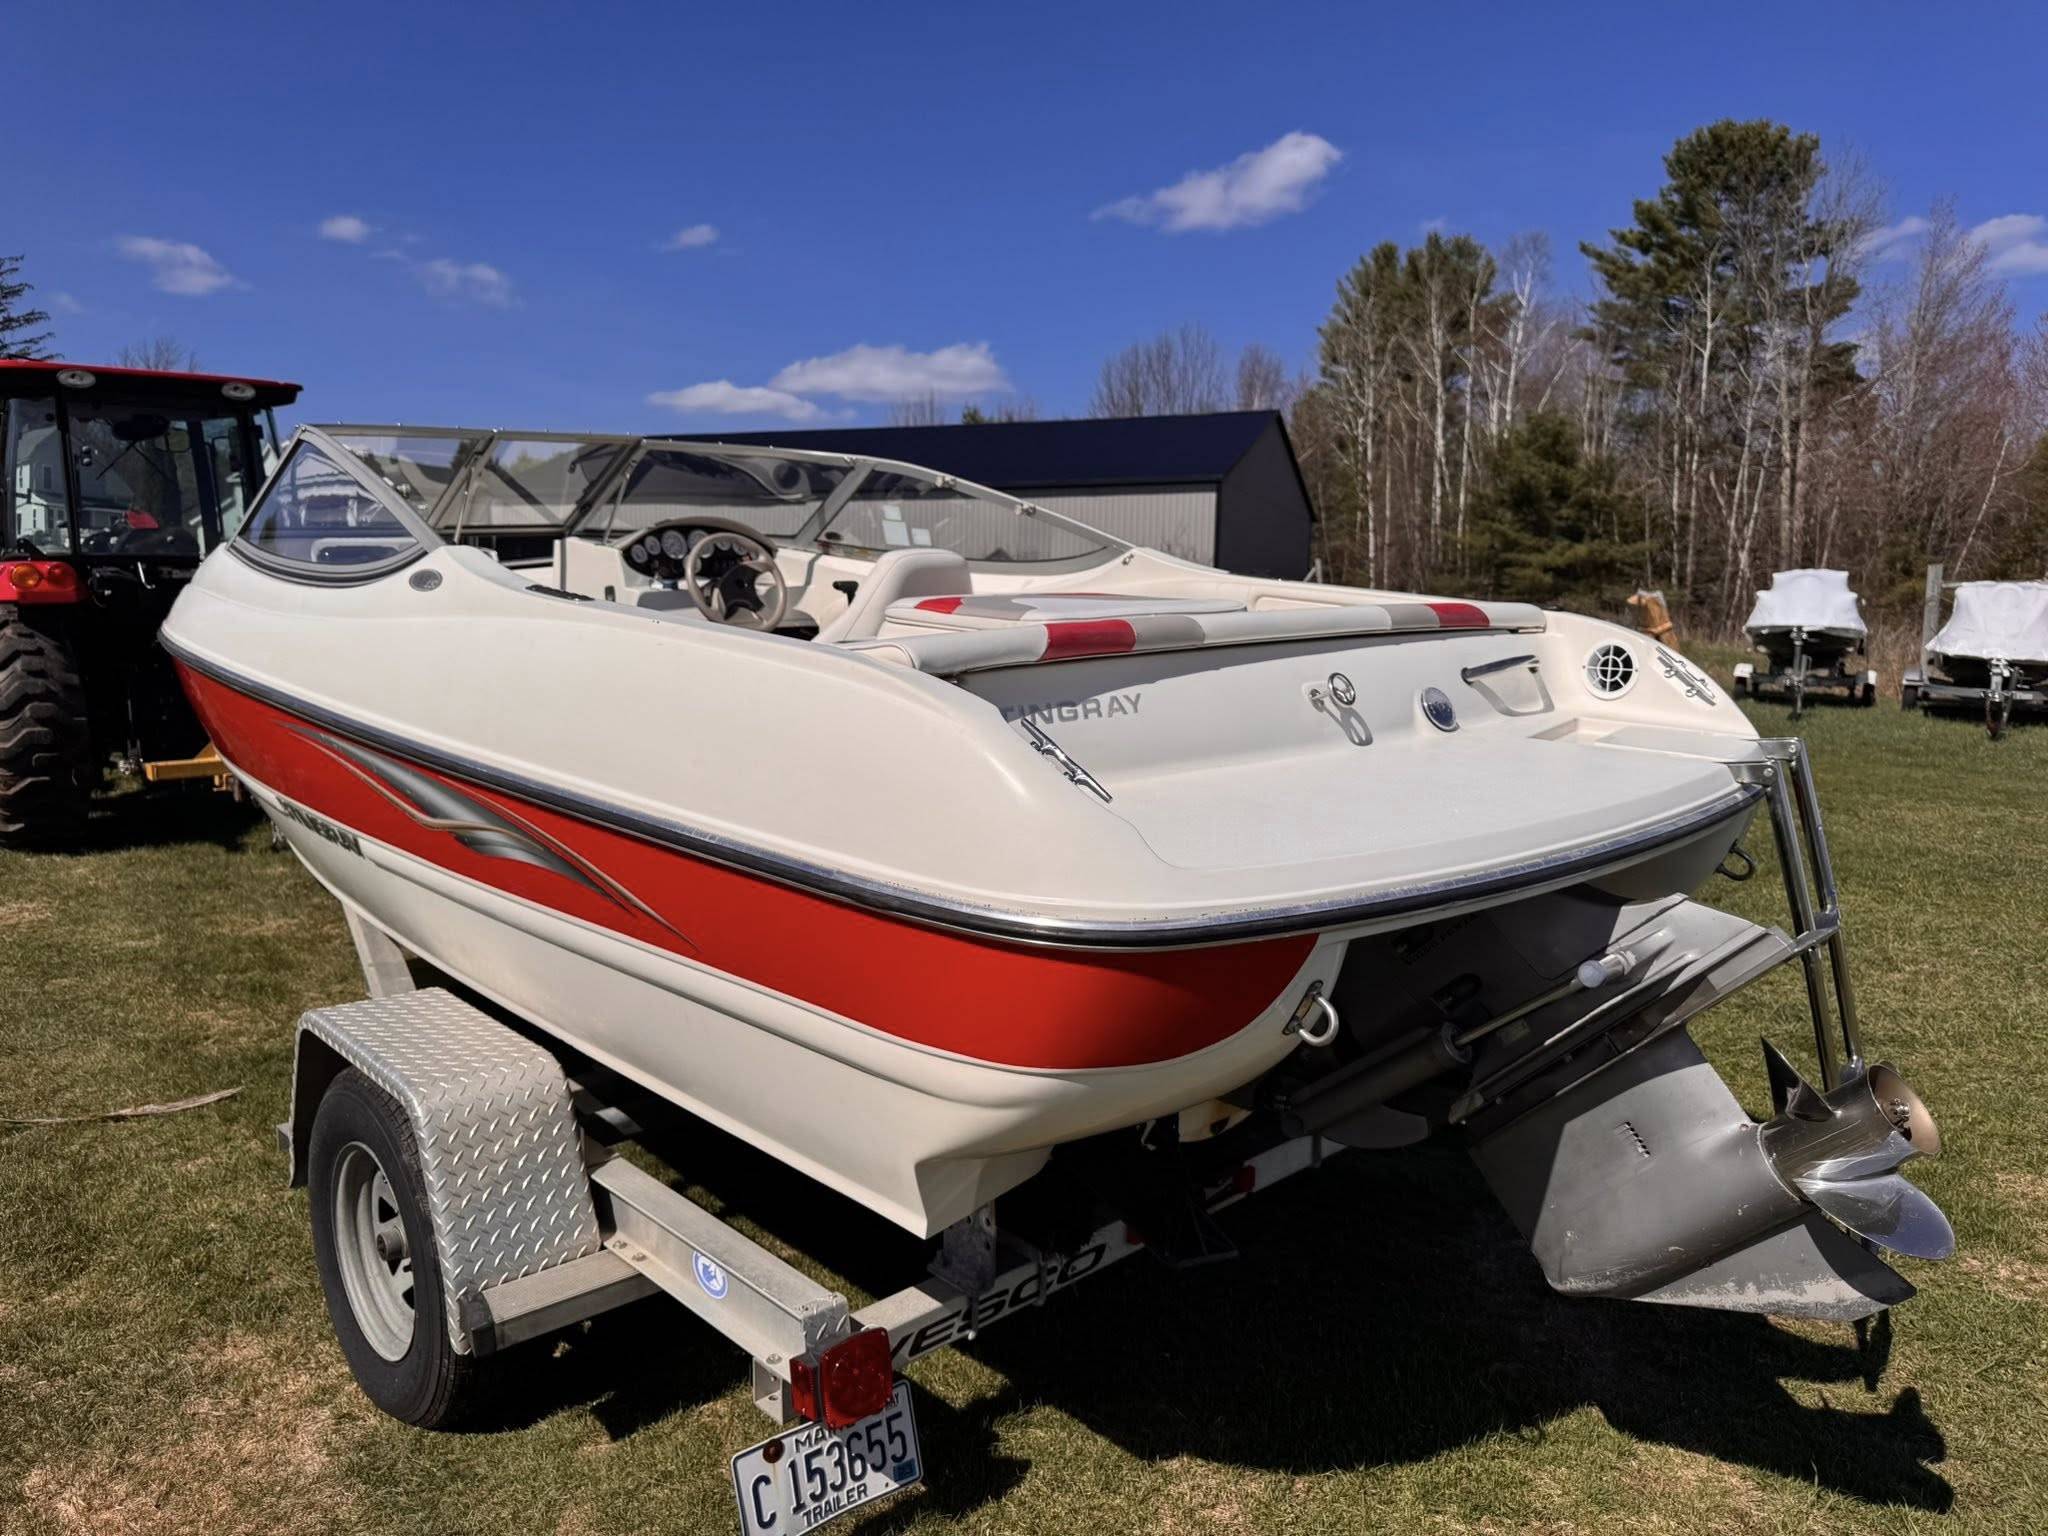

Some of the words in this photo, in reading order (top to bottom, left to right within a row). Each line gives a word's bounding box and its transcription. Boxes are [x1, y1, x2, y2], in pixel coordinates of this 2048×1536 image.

[999, 692, 1142, 726] TINGRAY
[751, 1474, 777, 1530] C
[787, 1411, 908, 1515] 153655
[801, 1482, 869, 1528] TRAILER
